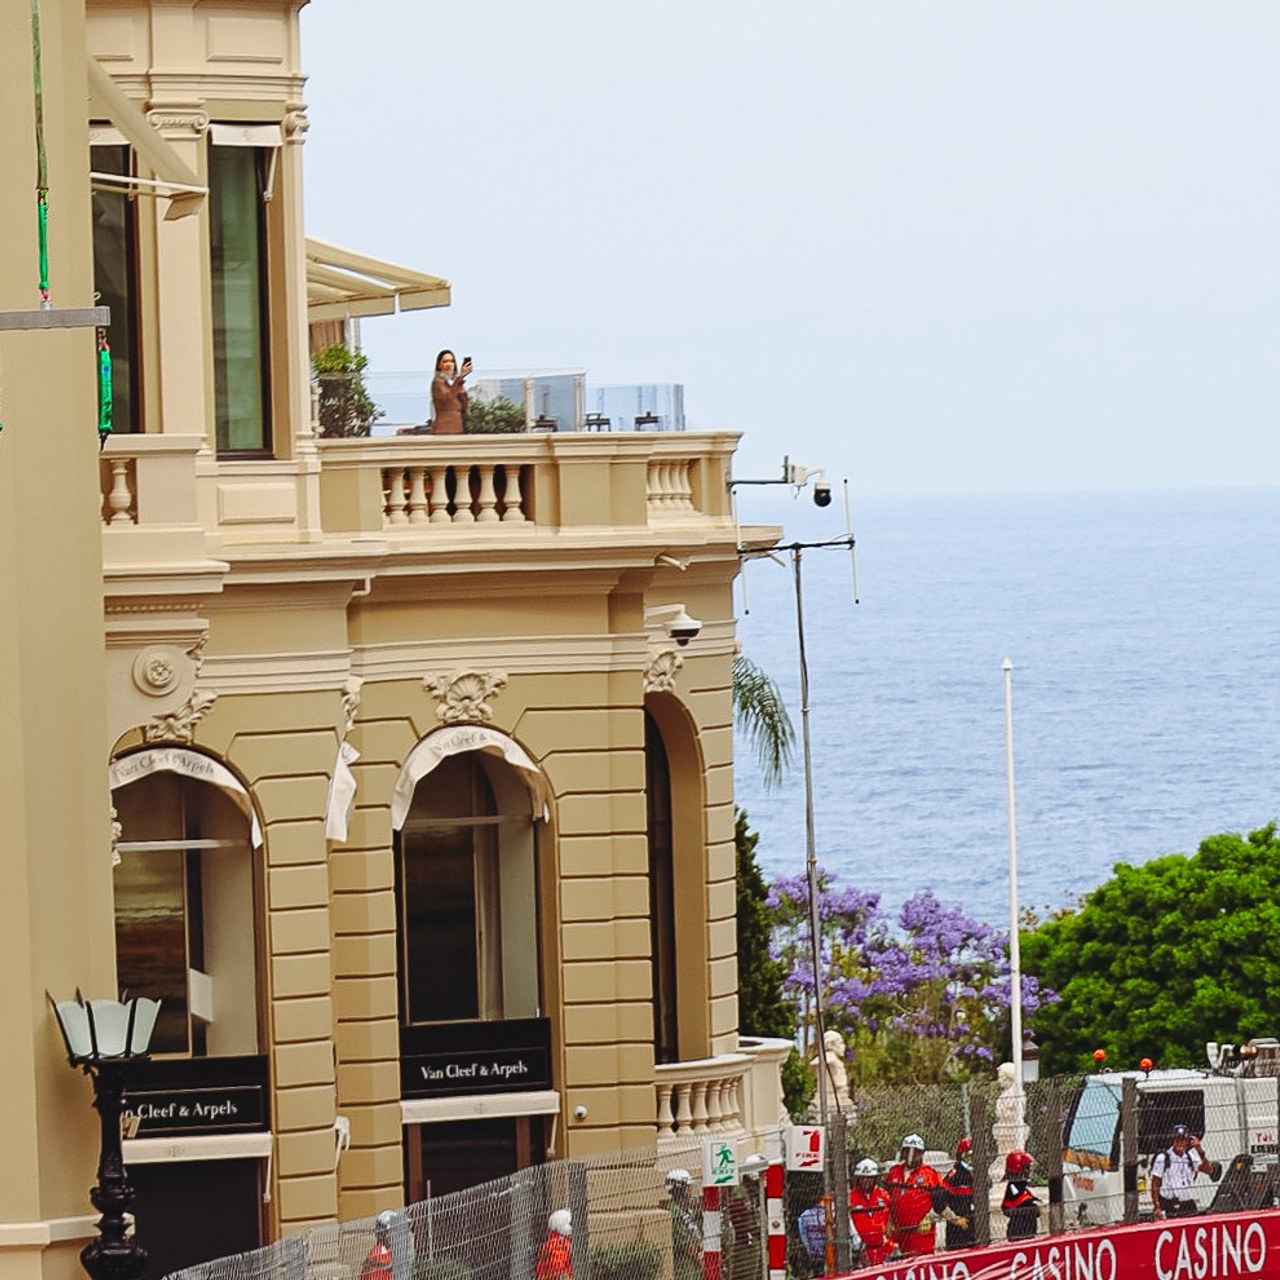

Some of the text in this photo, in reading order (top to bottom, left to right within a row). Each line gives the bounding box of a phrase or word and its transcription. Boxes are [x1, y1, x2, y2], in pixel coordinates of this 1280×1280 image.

[421, 1059, 529, 1080] Van Cleef & Arpels
[136, 1101, 177, 1120] Cleef
[178, 1105, 190, 1117] &
[192, 1100, 238, 1120] Arpels
